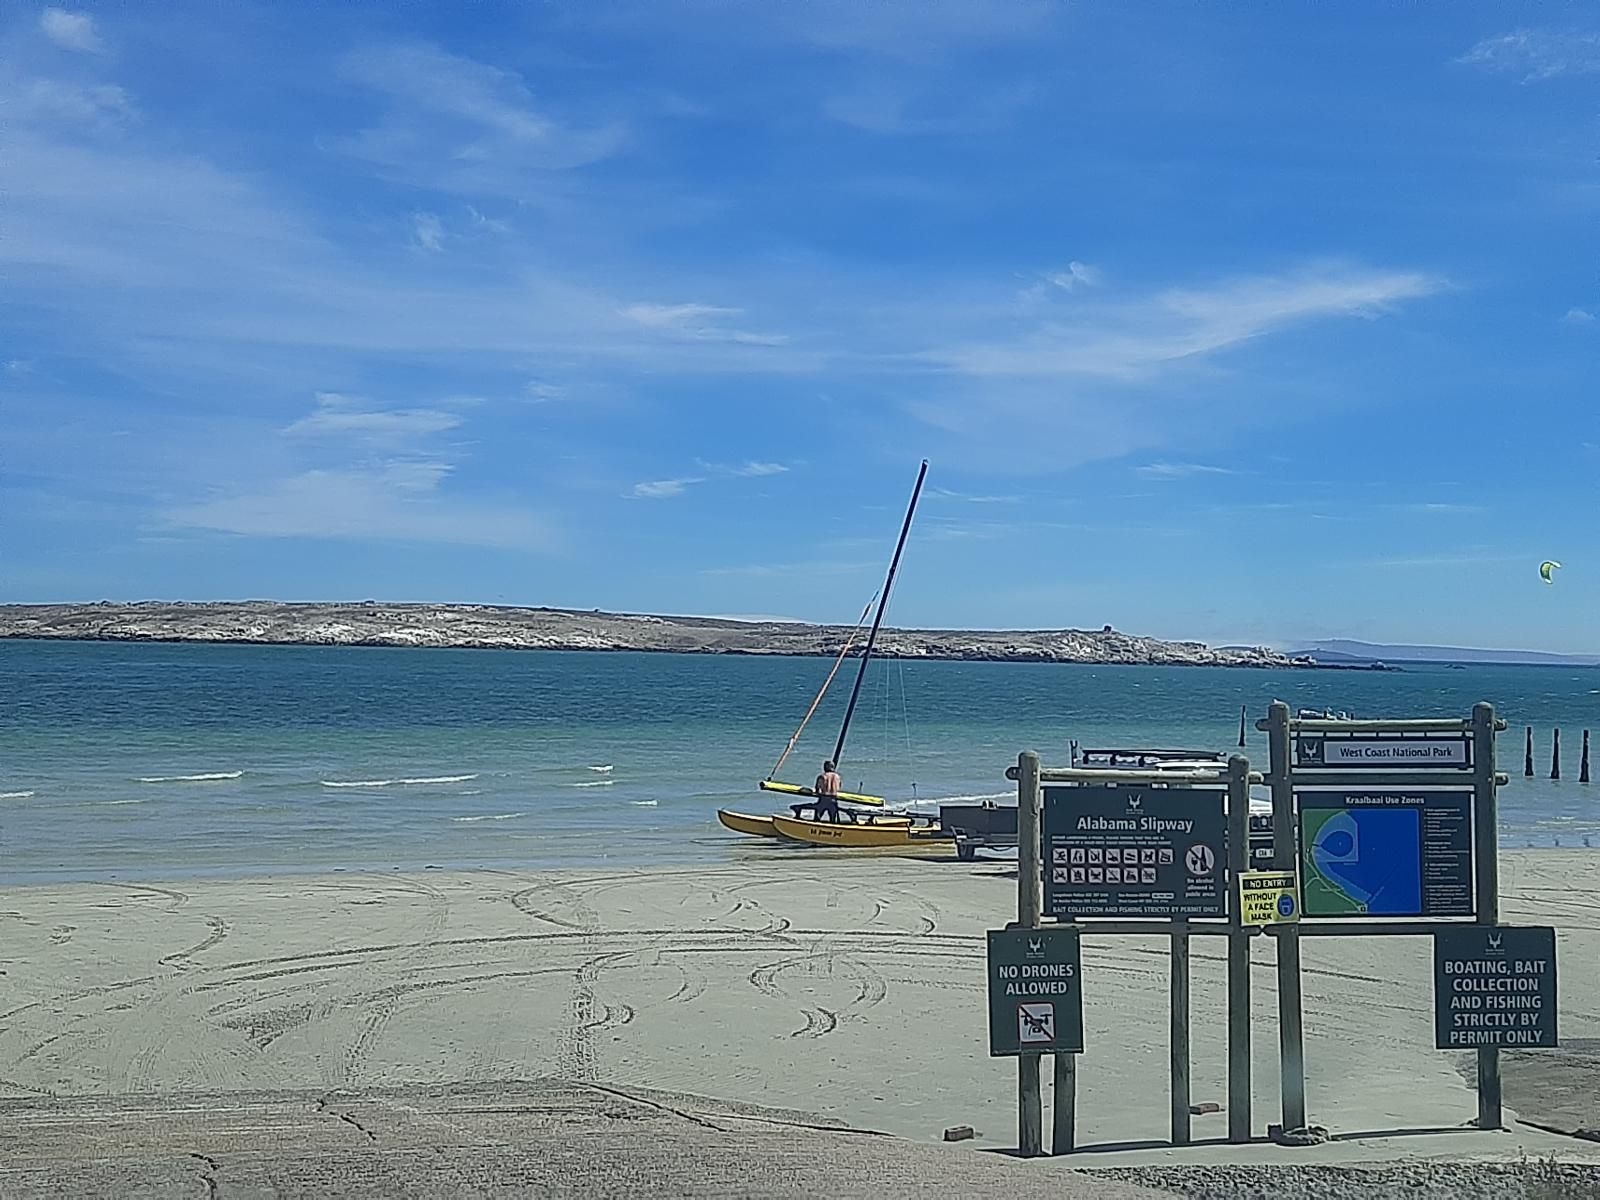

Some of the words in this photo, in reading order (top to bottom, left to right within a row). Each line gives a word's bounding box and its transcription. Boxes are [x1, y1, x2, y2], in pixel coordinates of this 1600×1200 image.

[1340, 748, 1362, 757] West
[1365, 748, 1390, 757] Coast
[1393, 747, 1430, 757] National
[1433, 748, 1452, 757] Park
[1077, 817, 1137, 830] Alabama
[1140, 817, 1193, 833] Slipway
[1244, 893, 1276, 901] WITHOUT
[1000, 966, 1018, 978] NO
[1022, 964, 1073, 977] DRONES
[1445, 961, 1511, 975] BOATING,
[1515, 961, 1546, 973] BAIT
[1006, 982, 1067, 995] ALLOWED
[1453, 979, 1538, 991] COLLECTION
[1450, 996, 1482, 1009] AND
[1486, 996, 1542, 1008] FISHING
[1454, 1013, 1516, 1026] STRICTLY
[1521, 1013, 1539, 1025] BY
[1450, 1031, 1502, 1043] PERMIT
[1506, 1030, 1542, 1043] ONLY
